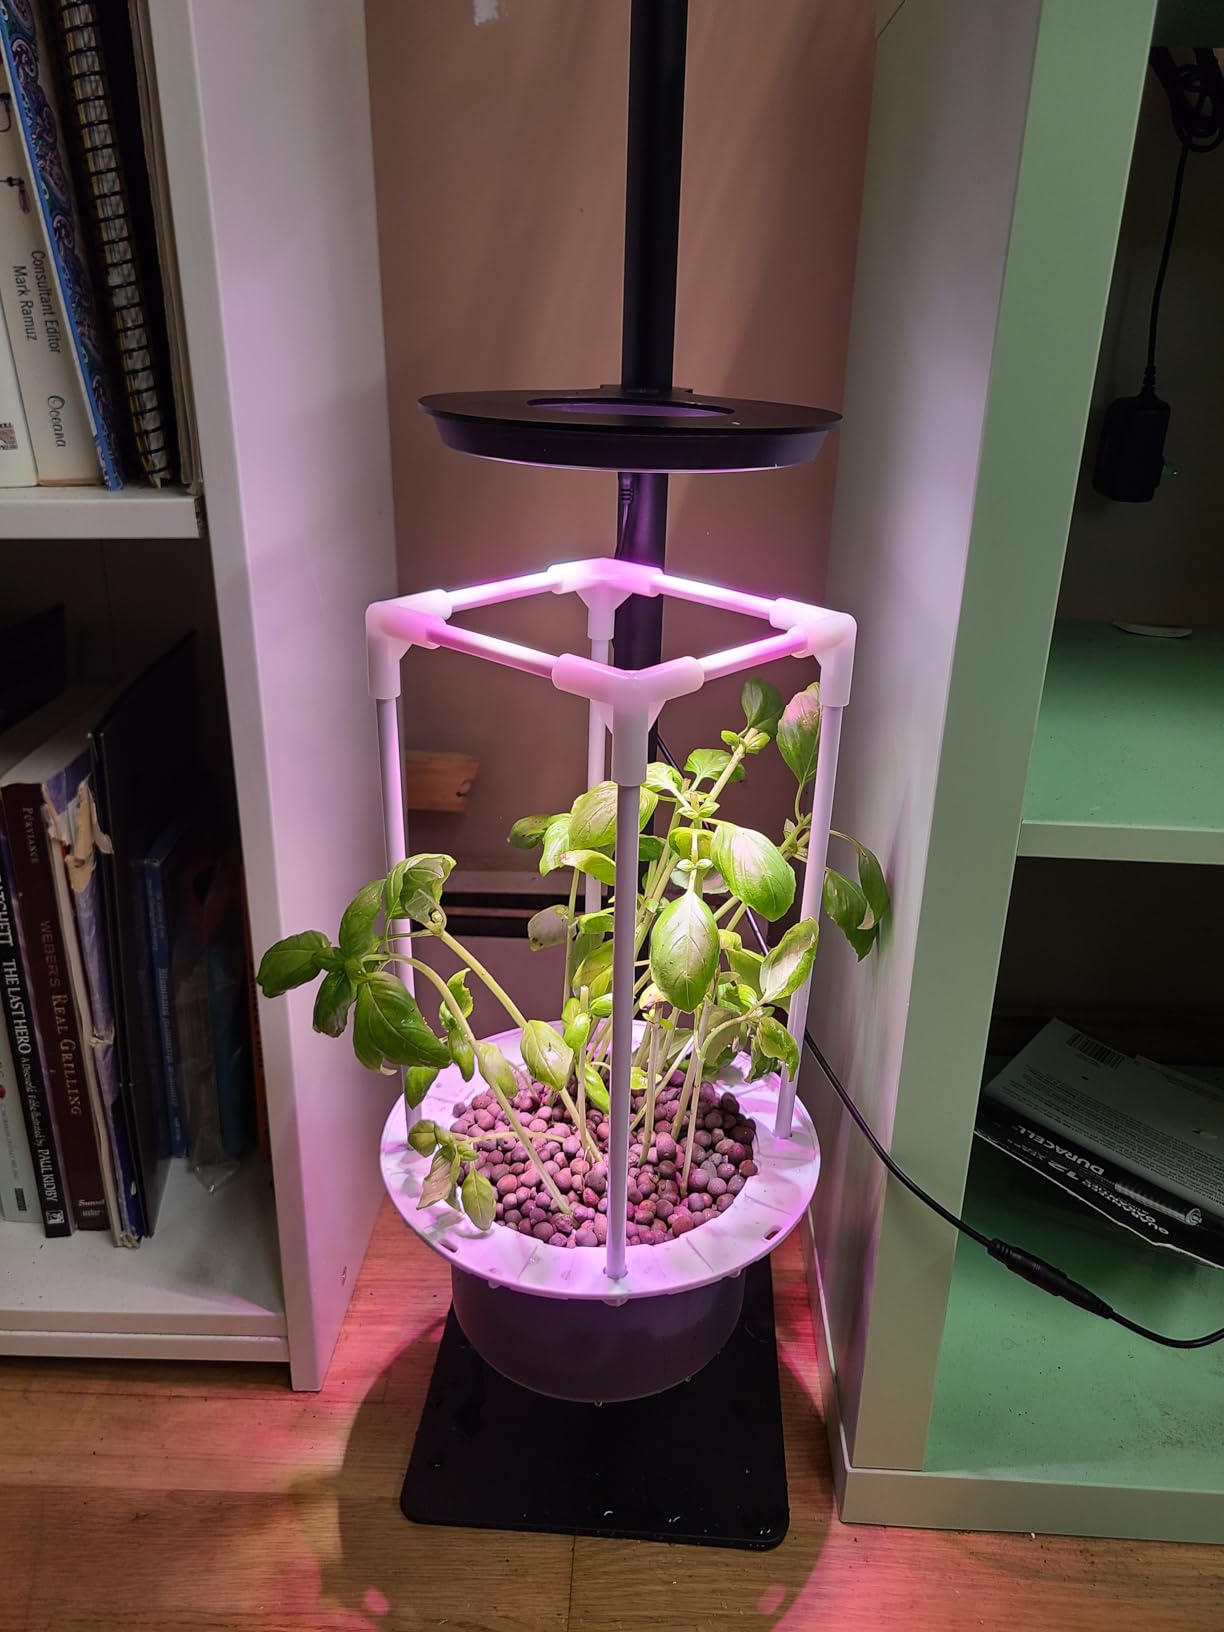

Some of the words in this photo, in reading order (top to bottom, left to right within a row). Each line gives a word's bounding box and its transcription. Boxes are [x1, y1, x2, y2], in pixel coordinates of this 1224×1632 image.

[13, 265, 31, 296] Mark
[31, 251, 55, 317] Consultant
[44, 319, 61, 353] Editor
[20, 300, 37, 341] Ramuz
[47, 395, 66, 448] Oceana
[2, 958, 20, 986] THE
[8, 987, 26, 1018] LAST
[13, 1019, 32, 1054] HERO
[51, 991, 69, 1034] REAL
[60, 1038, 82, 1115] GRILLING
[38, 1149, 53, 1173] PAUL
[1016, 1123, 1105, 1175] DURACELL
[42, 1173, 59, 1202] KIDBY
